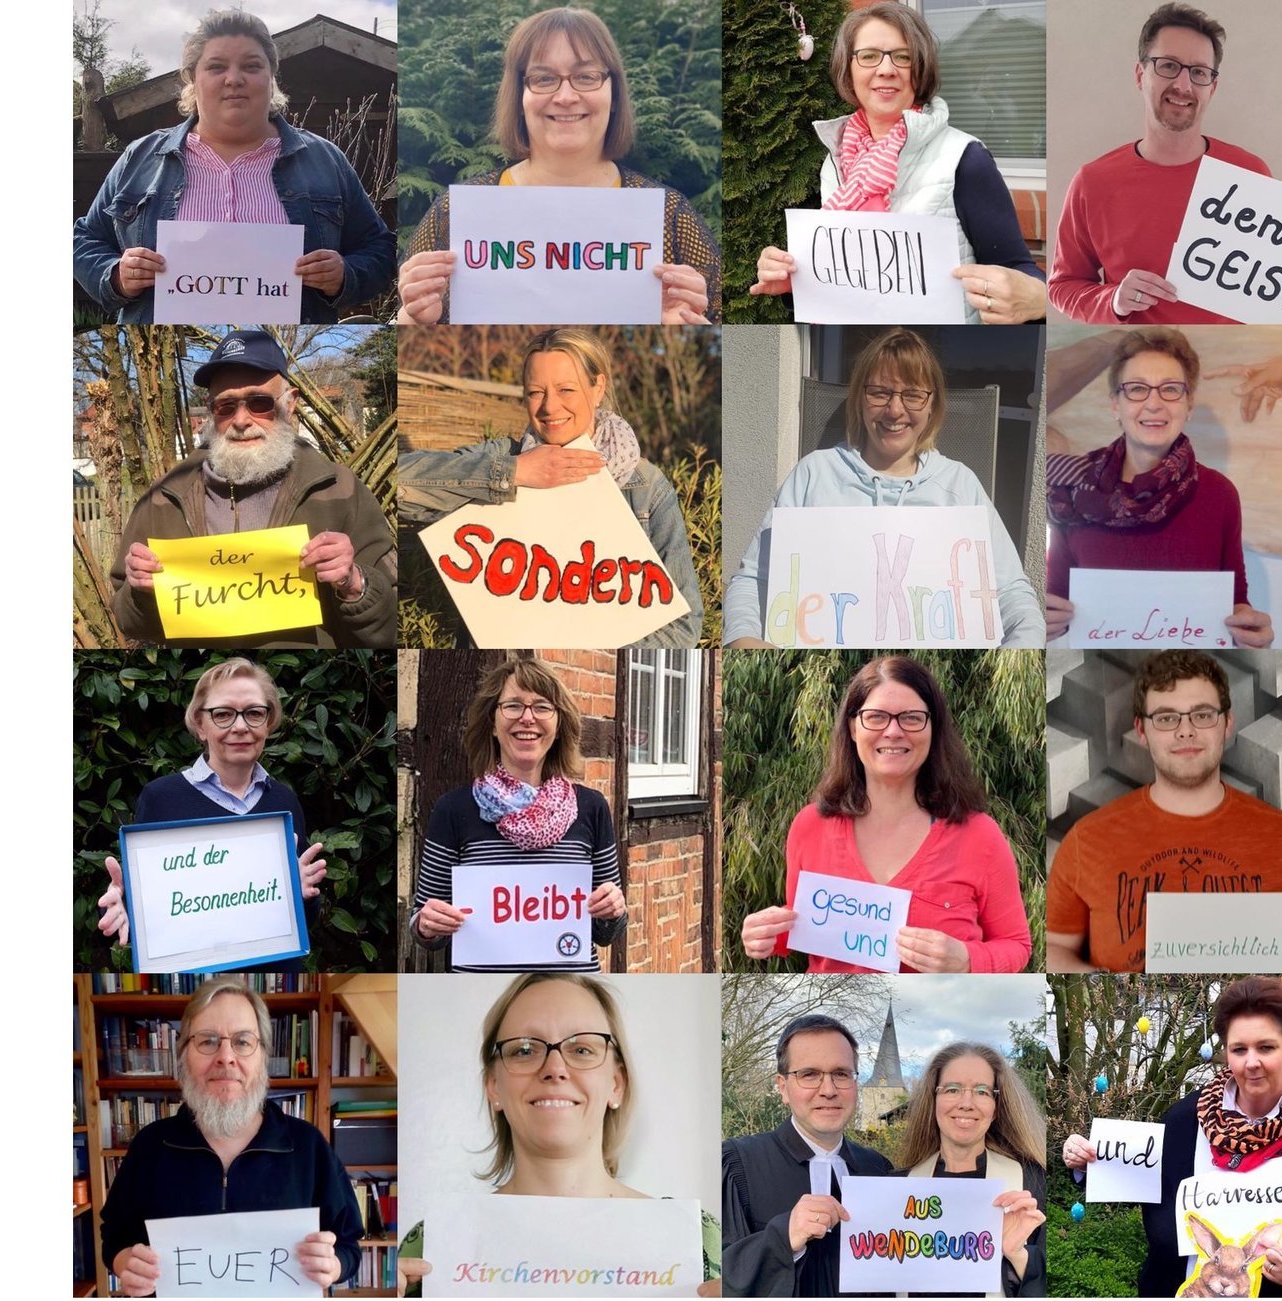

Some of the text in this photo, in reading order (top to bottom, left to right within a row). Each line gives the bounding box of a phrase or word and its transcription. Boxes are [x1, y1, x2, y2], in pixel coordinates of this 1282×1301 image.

[465, 240, 651, 271] UNS NICHT
[812, 226, 927, 297] GEGEBEN
[256, 278, 290, 298] hat
[209, 549, 255, 567] der
[439, 523, 673, 608] Sondern
[173, 571, 307, 616] Furcht,
[770, 532, 999, 646] der Kraft
[1088, 607, 1206, 641] der Liebe
[163, 844, 230, 872] und der
[1140, 847, 1240, 872] OUTDOOR AND WILDLIFE
[171, 878, 282, 917] Besonnenheit.
[492, 883, 587, 924] Bleibt
[811, 887, 892, 927] gesund
[844, 930, 888, 959] und
[1096, 1135, 1160, 1171] und
[904, 1194, 944, 1221] AUS
[172, 1246, 301, 1287] EUER
[453, 1262, 679, 1286] Kirchenvorstand
